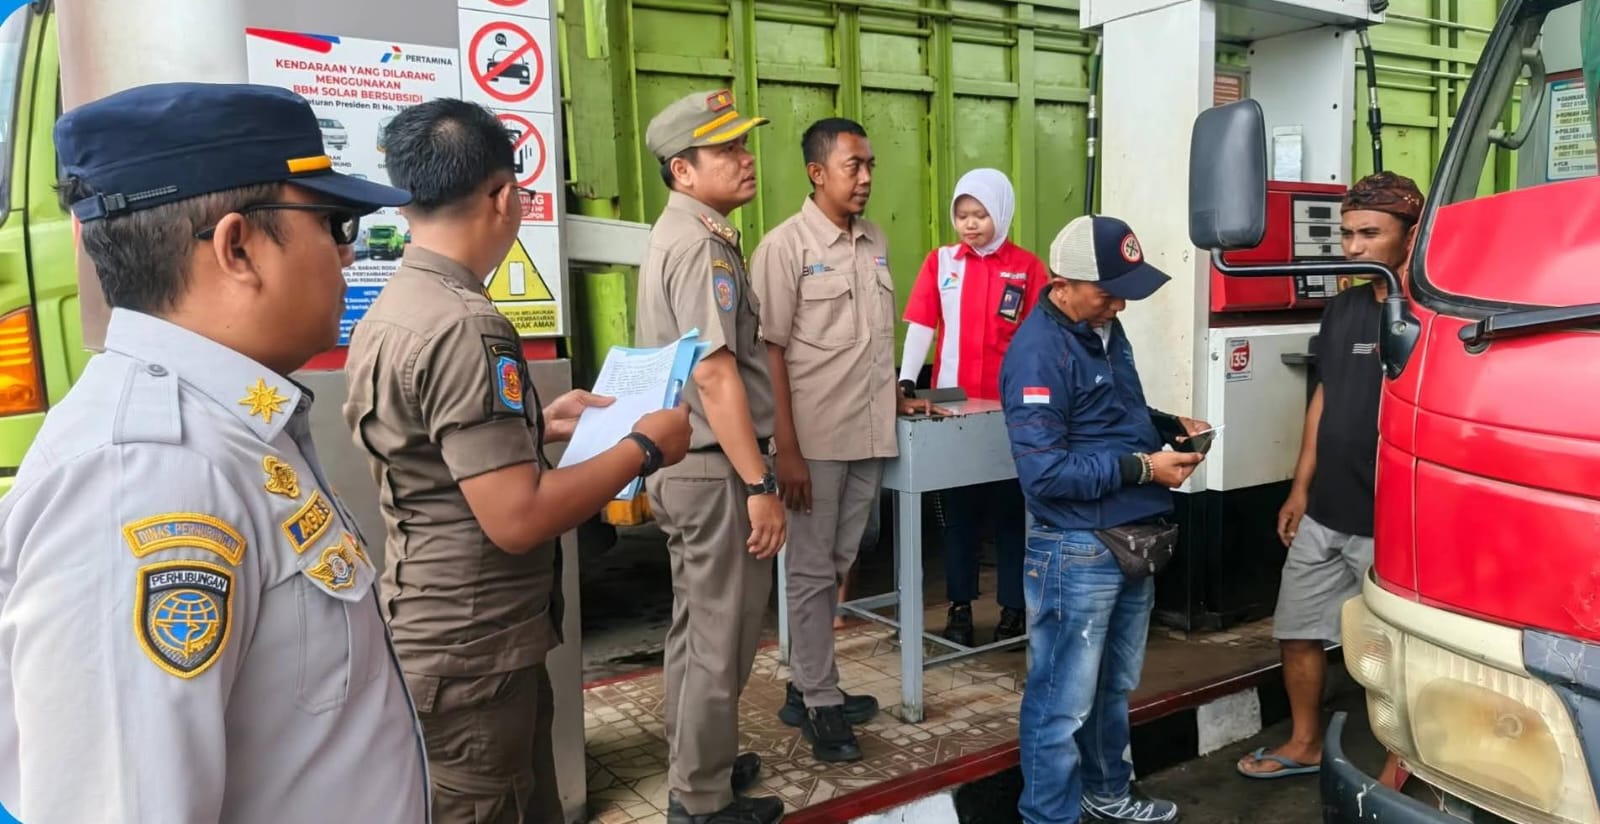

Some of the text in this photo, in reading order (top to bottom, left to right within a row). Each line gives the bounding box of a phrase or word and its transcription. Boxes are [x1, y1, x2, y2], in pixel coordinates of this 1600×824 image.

[405, 54, 453, 66] PERTAMINA
[275, 58, 437, 82] KENDARAAN YANG DILARANG
[315, 74, 401, 90] MENGGUNAKAN
[293, 84, 424, 103] BBM SOLAR BERSUBSIDI
[309, 99, 333, 107] aturan
[335, 100, 371, 109] Presiden
[372, 102, 381, 110] RI
[382, 103, 395, 111] No.
[1231, 351, 1248, 367] 135
[136, 523, 170, 543] DINAS
[151, 571, 227, 591] PERHUBUNGAN
